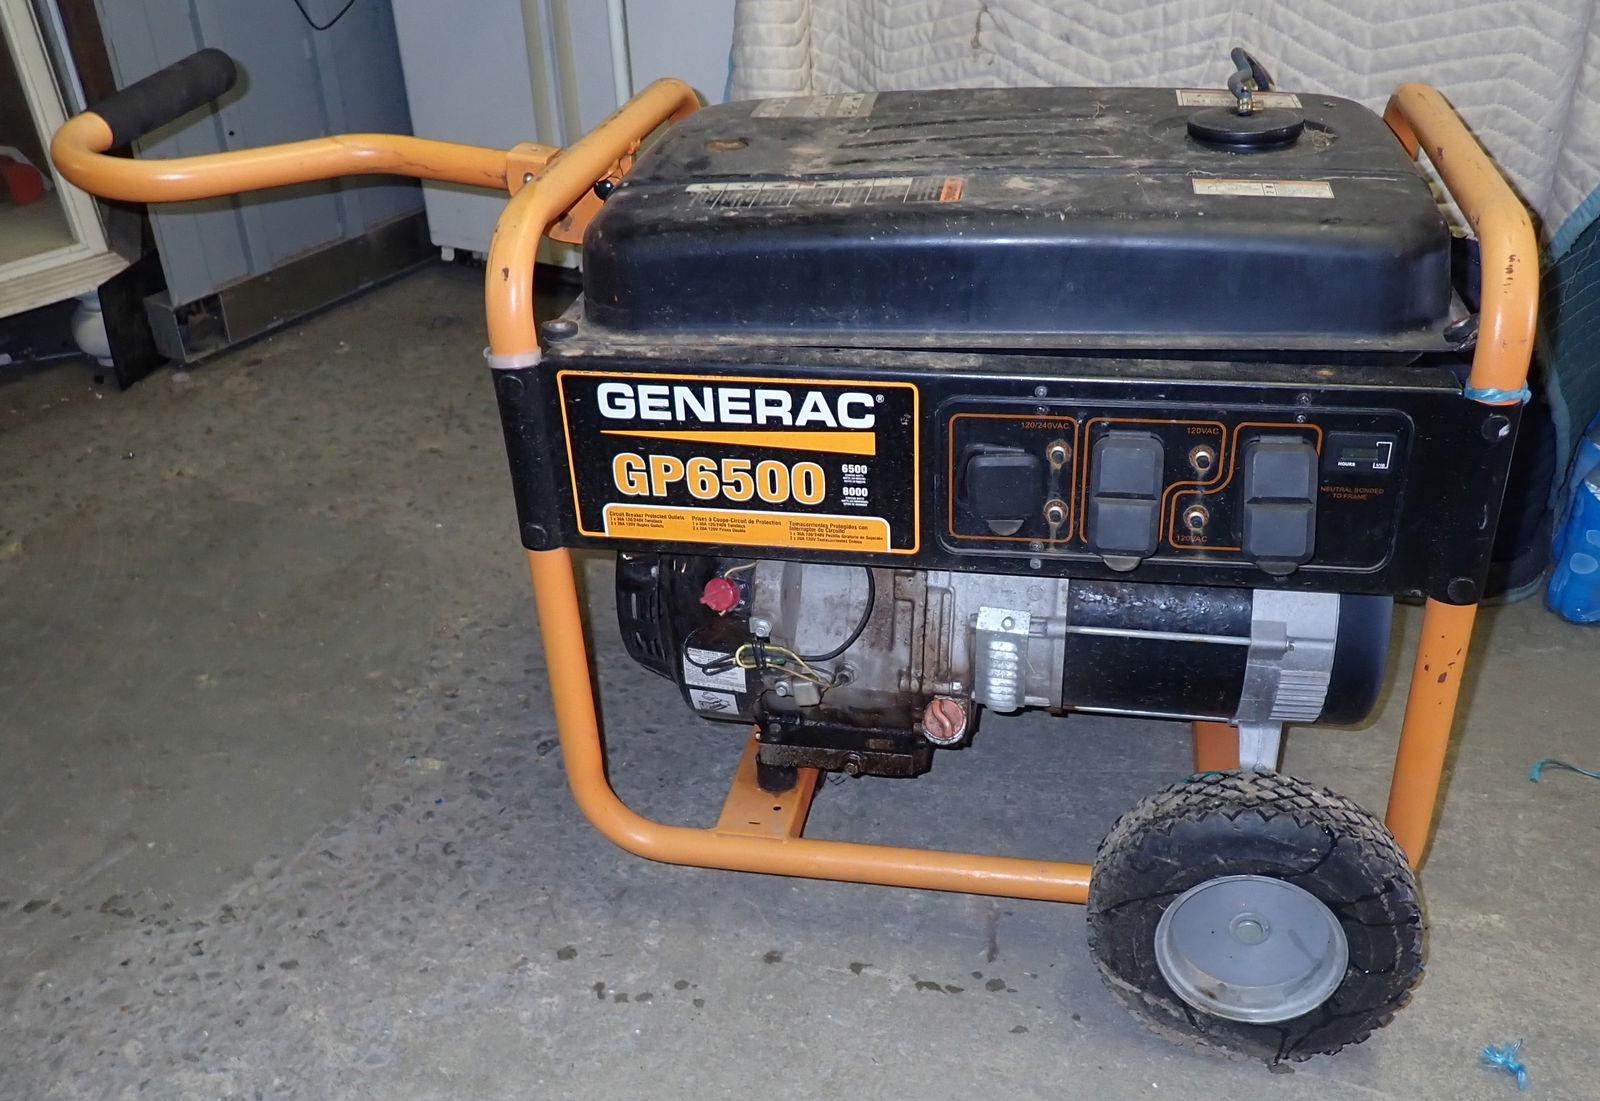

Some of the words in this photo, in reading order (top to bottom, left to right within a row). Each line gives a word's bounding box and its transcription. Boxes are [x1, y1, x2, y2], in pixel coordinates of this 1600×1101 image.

[842, 464, 868, 474] 6500
[612, 452, 826, 505] GP6500
[842, 487, 868, 497] 8000
